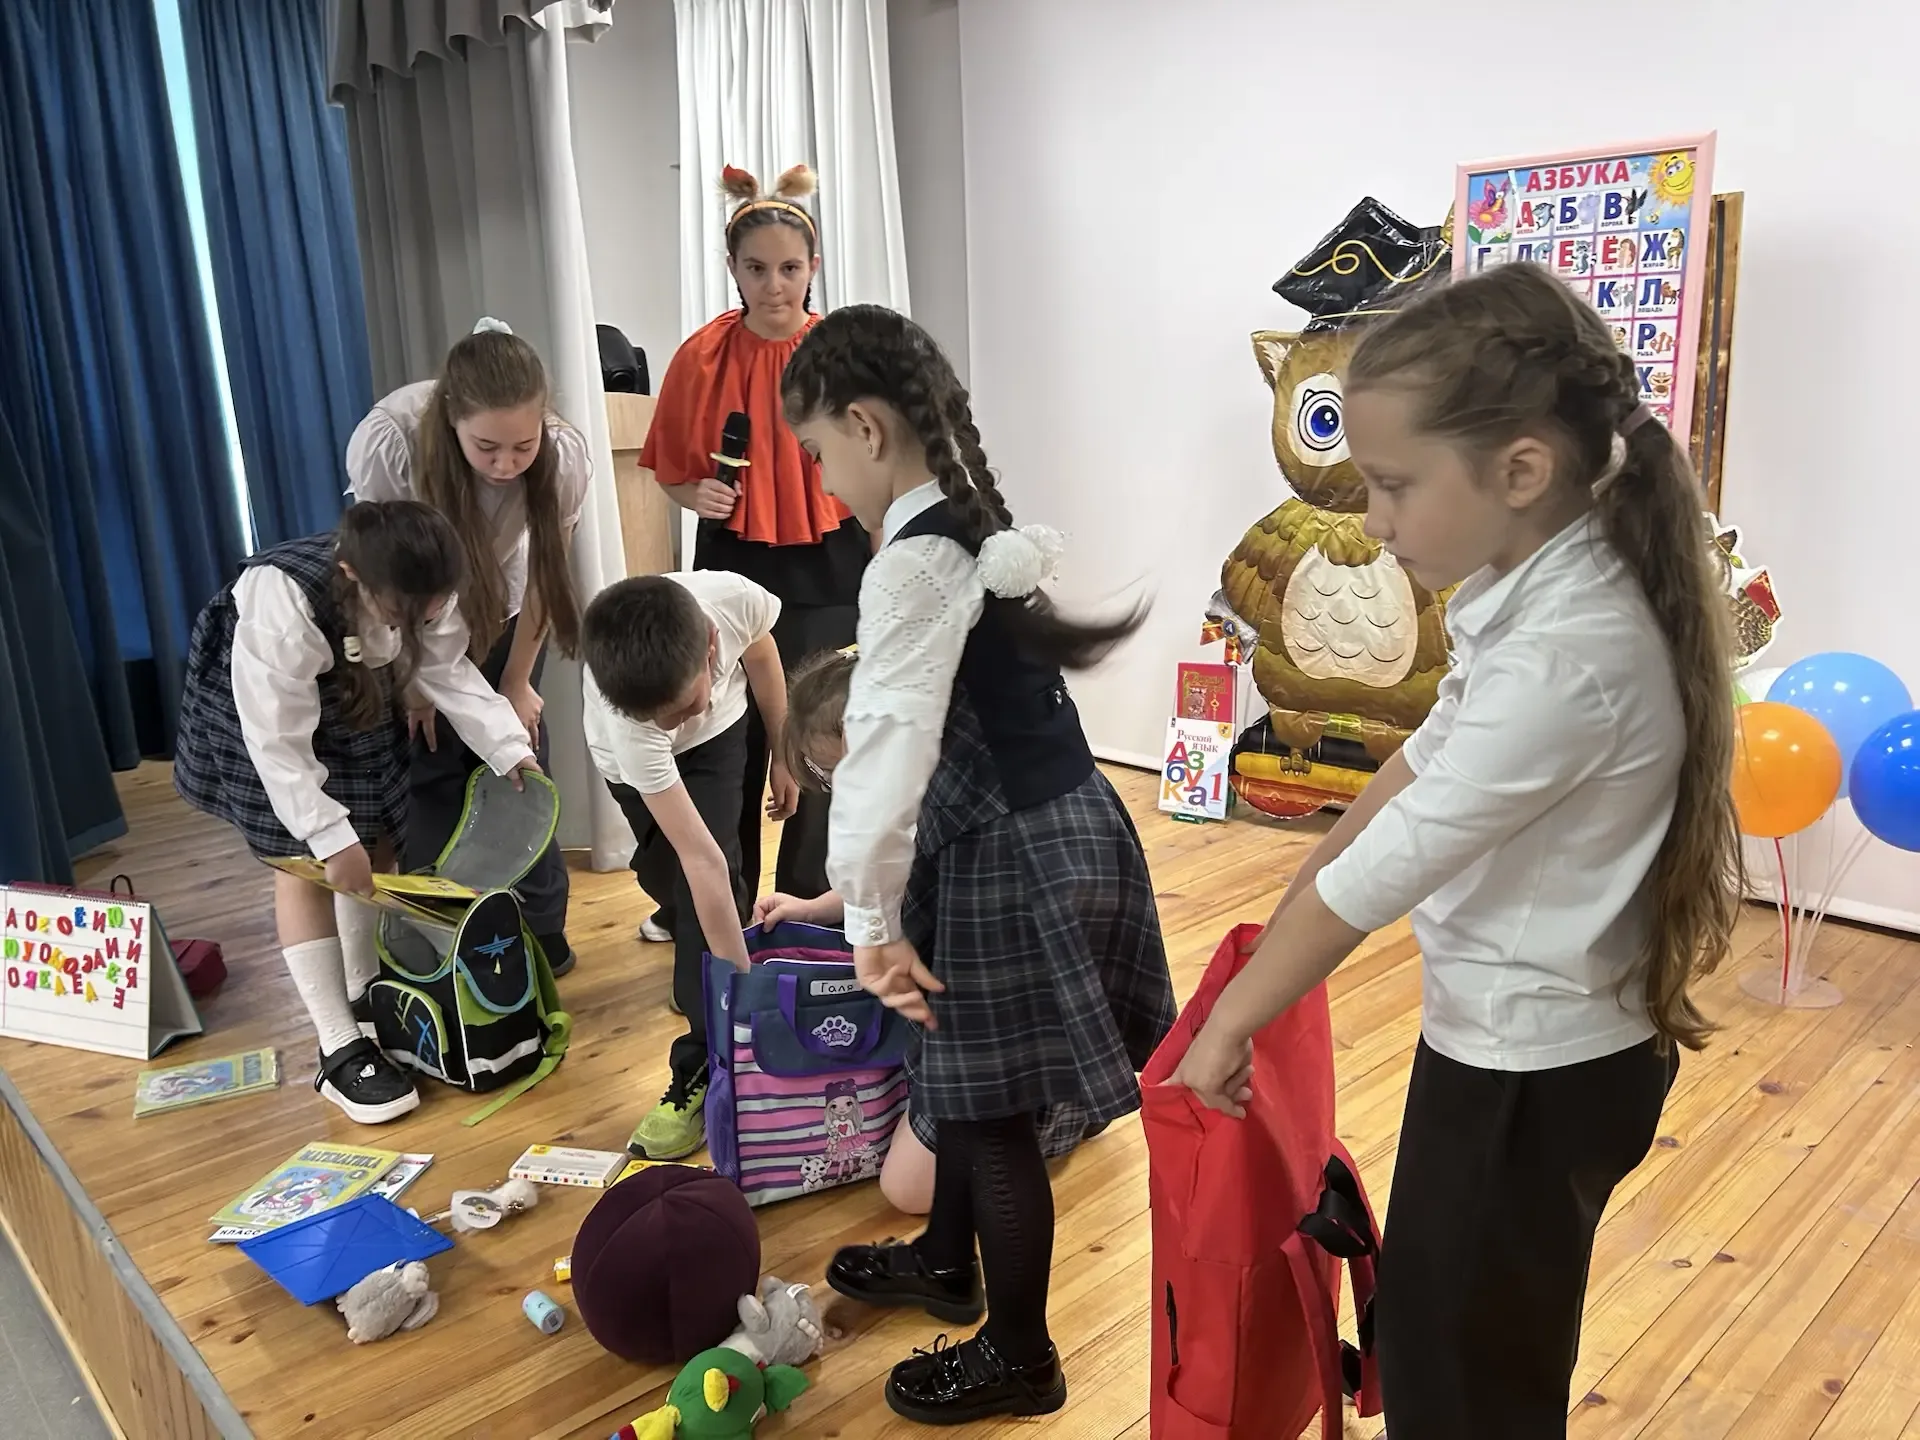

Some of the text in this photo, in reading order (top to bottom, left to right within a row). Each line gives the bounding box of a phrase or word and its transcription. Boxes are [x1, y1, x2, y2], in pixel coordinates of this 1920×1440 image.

[1525, 160, 1630, 192] АЗБУКА
[1516, 192, 1622, 228] А Б В
[1558, 240, 1574, 267] Е
[1601, 235, 1618, 264] Ё
[1641, 233, 1669, 262] Ж
[1597, 278, 1662, 308] К Л
[1637, 323, 1657, 350] Р
[1177, 729, 1212, 744] Русский
[1209, 771, 1222, 802] 1
[821, 982, 854, 993] Галя
[298, 1149, 384, 1168] МАТЕМАТИКА
[219, 1228, 261, 1236] КЛАСС
